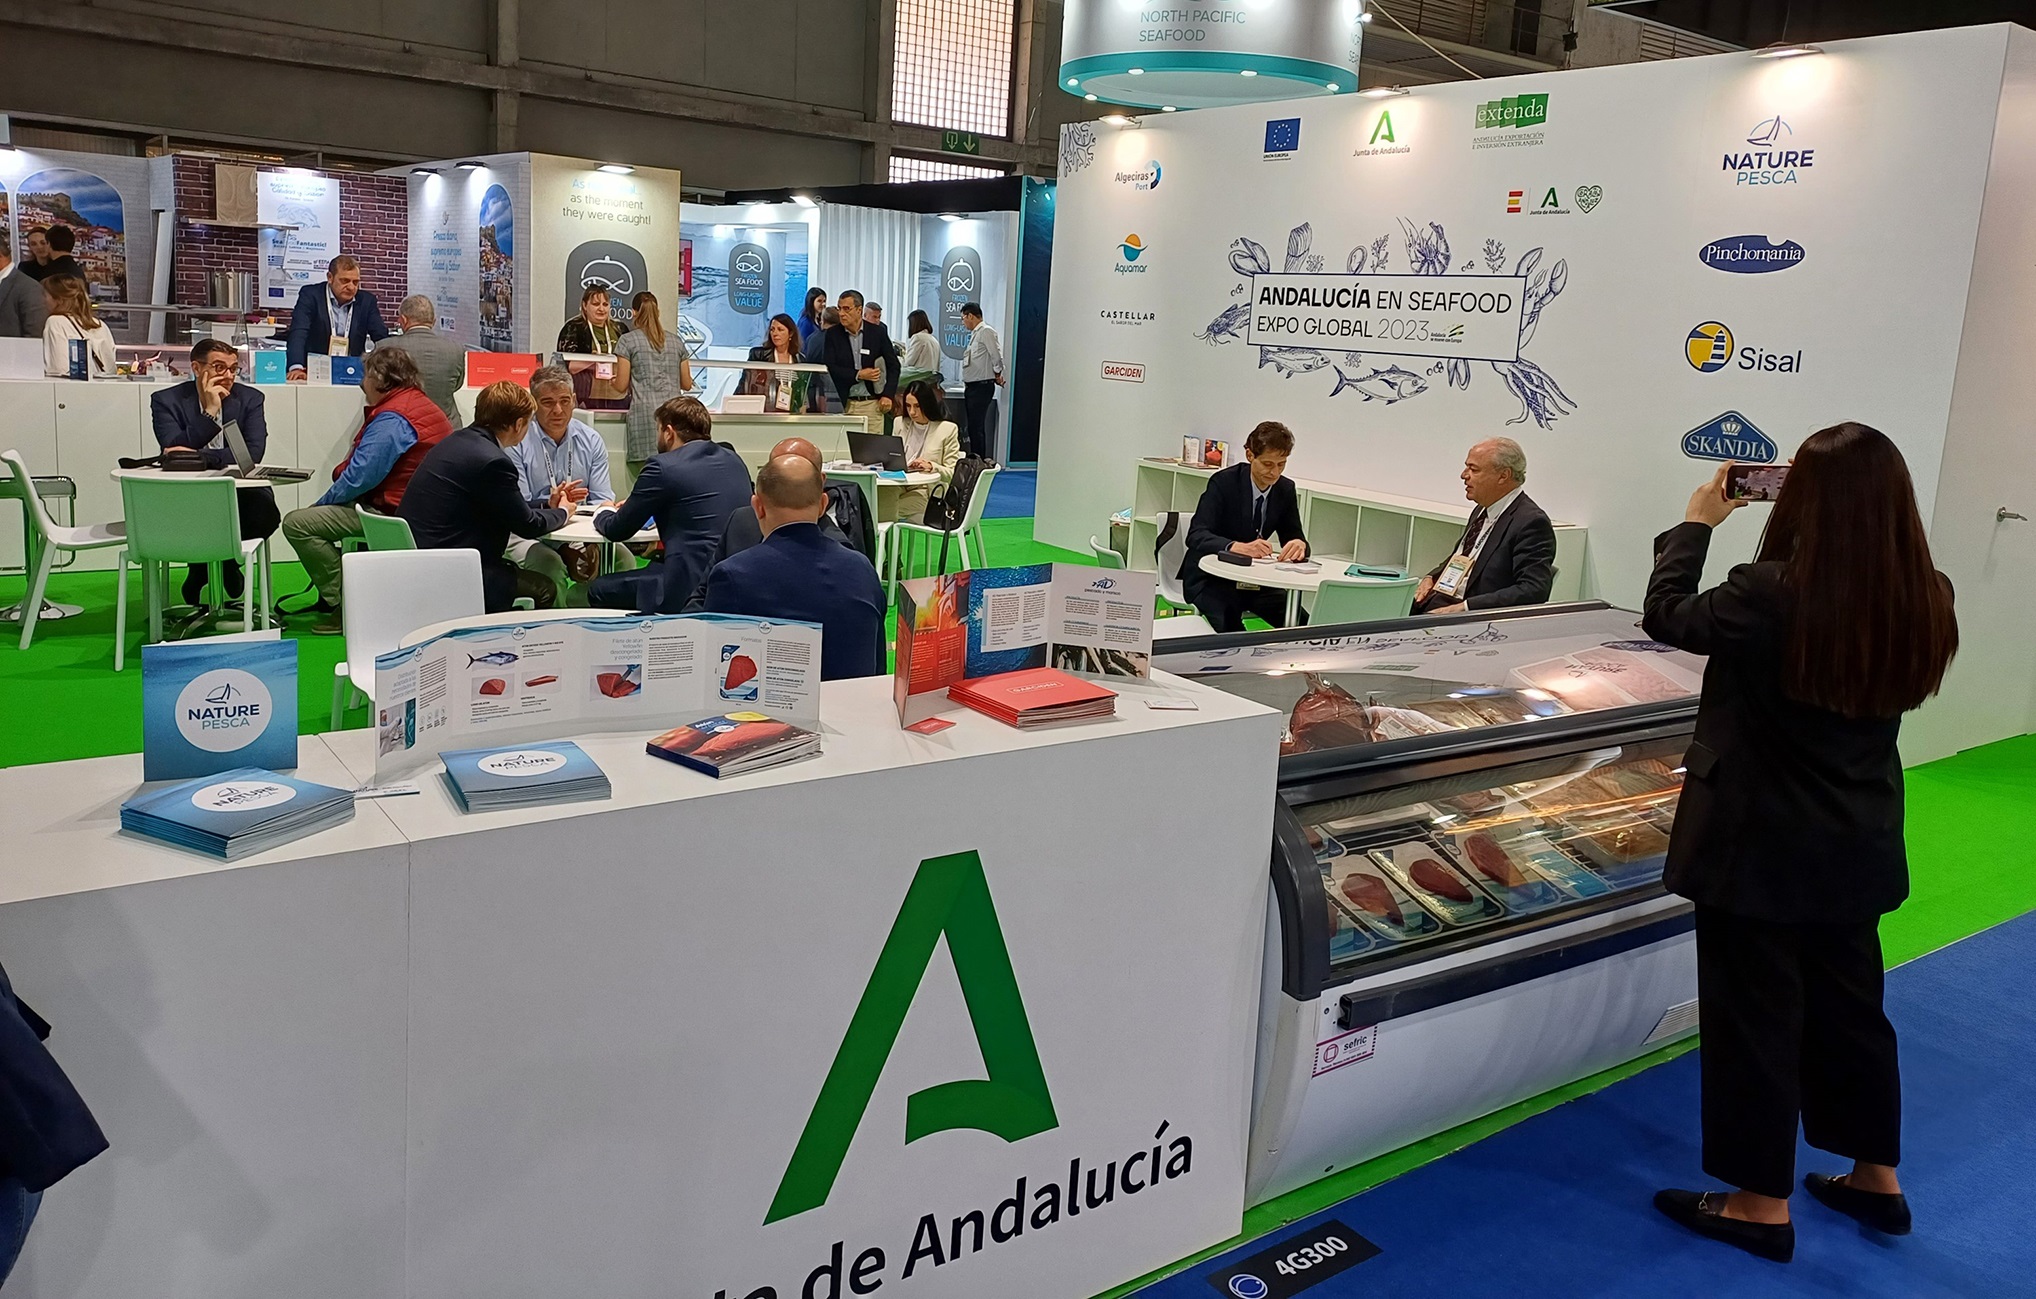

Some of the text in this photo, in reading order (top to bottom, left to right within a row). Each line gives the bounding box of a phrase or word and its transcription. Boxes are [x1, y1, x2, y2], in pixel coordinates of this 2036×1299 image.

[1140, 10, 1246, 24] NORTH PACIFIC
[1139, 29, 1206, 42] SEAFOOD
[1477, 98, 1544, 122] extenda
[1722, 149, 1815, 170] NATURE
[1115, 171, 1149, 184] Algeciras
[1736, 170, 1797, 185] PESCA
[570, 195, 643, 210] as the moment
[563, 207, 651, 226] they were caught!
[1705, 242, 1802, 263] Pinchomania
[1114, 263, 1148, 276] Aquamar
[735, 277, 746, 285] SEA
[735, 297, 763, 308] VALUE
[1259, 283, 1512, 314] ANDALUCÍA EN SEAFOOD
[609, 308, 633, 320] OOD
[946, 302, 956, 312] SEA
[1100, 310, 1155, 320] CASTELLAR
[1257, 316, 1430, 341] EXPO GLOBAL 2023
[1737, 347, 1802, 373] Sisal
[1104, 365, 1142, 378] GARCIDEN
[1687, 435, 1769, 460] SKANDIA
[188, 704, 260, 721] NATURE
[201, 718, 250, 730] PESCA
[490, 757, 556, 769] NATURE
[213, 785, 279, 806] NATURE
[1343, 1036, 1368, 1051] sefric
[800, 1118, 1194, 1299] de Andalucía
[1275, 1236, 1349, 1276] 4G300
